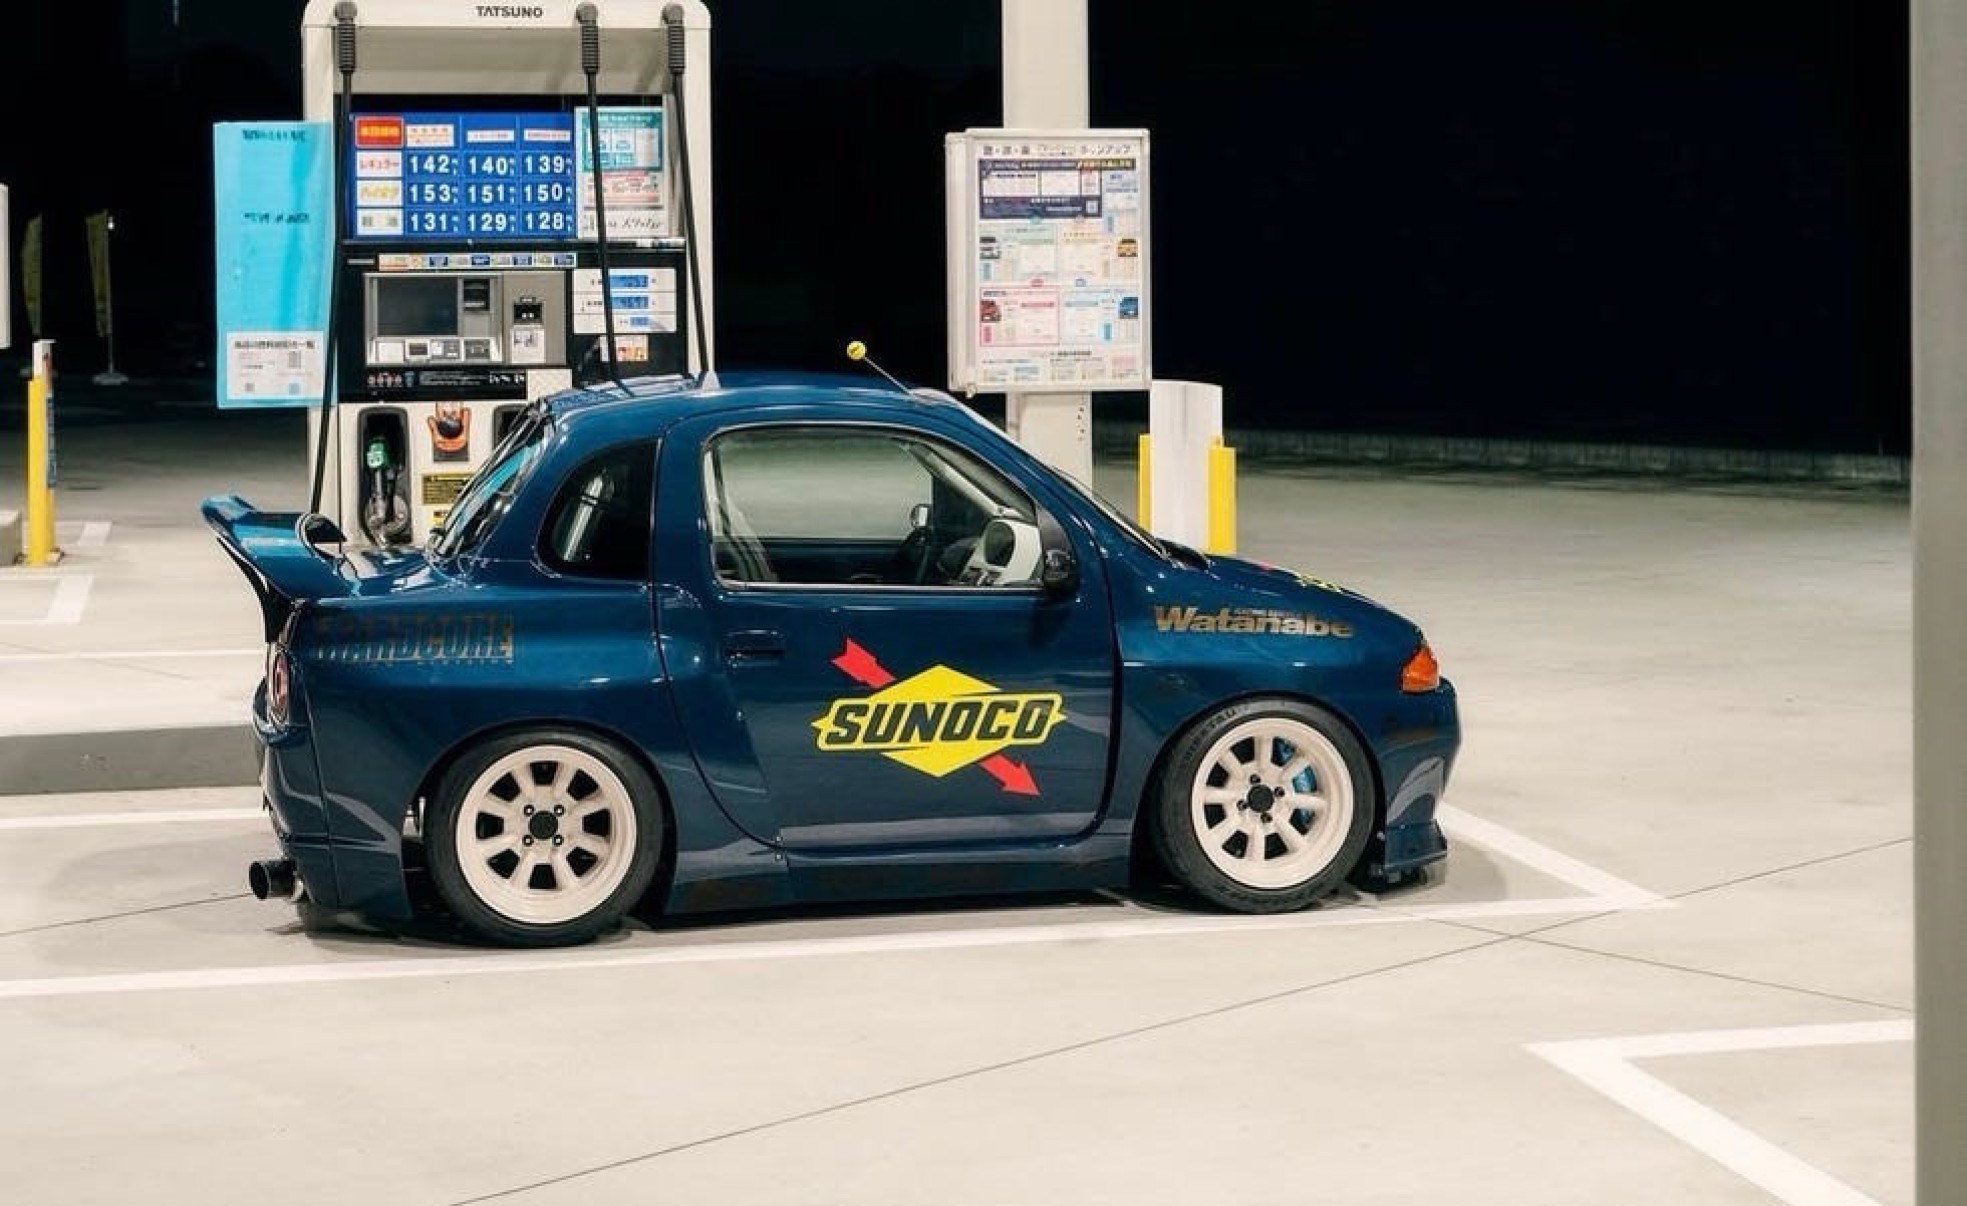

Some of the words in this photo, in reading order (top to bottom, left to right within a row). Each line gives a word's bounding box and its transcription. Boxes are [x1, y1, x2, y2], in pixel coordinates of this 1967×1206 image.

[475, 5, 543, 18] TATSUNO
[410, 154, 450, 174] 142
[469, 155, 508, 175] 140
[525, 154, 564, 174] 139
[409, 183, 451, 203] 153
[468, 183, 505, 204] 151
[524, 182, 563, 203] 150
[410, 211, 448, 232] 131
[467, 212, 507, 232] 129
[525, 211, 565, 231] 128
[1154, 605, 1354, 638] Watanabe
[825, 698, 1057, 745] SUNOCO
